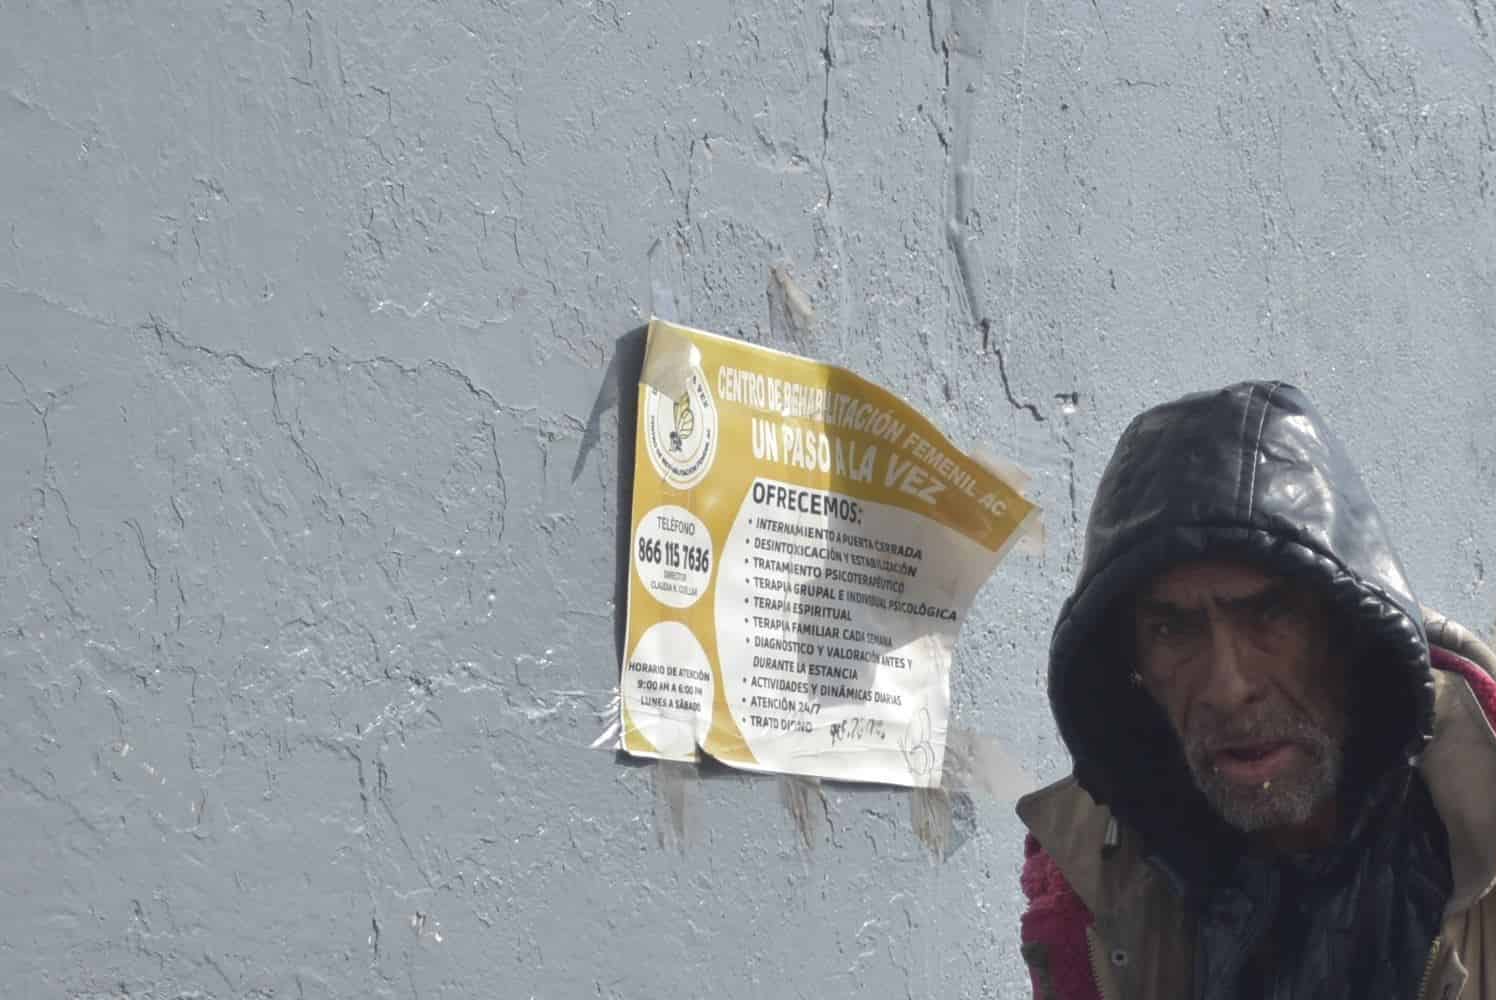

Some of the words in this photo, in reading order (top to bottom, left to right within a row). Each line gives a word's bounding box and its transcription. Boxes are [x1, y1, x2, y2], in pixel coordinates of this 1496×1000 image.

[718, 366, 765, 409] CENTRO
[767, 378, 783, 411] DE
[782, 382, 904, 442] REHABILITACIÓN
[903, 432, 976, 496] FEMENIL
[978, 493, 1007, 516] AC
[752, 417, 778, 462] UN
[782, 424, 831, 472] PASO
[835, 437, 847, 477] A
[851, 440, 877, 484] LA
[885, 453, 945, 504] VEZ
[752, 482, 864, 525] OFRECEMOS:
[657, 515, 695, 536] TELÉFONO
[754, 537, 842, 562] DESINTOXICACIÓN
[756, 517, 835, 541] INTERNAMIENTO
[842, 533, 873, 550] PUERTA
[875, 540, 923, 560] CERRADA
[639, 536, 661, 564] 866
[665, 541, 680, 568] 115
[682, 545, 709, 573] 7636
[753, 556, 821, 578] TRATAMIENTO
[753, 576, 792, 593] TERAPIA
[794, 583, 836, 600] GRUPAL
[889, 599, 957, 621] PSICOLÓGICA
[753, 596, 791, 613] TERAPIA
[792, 602, 852, 621] ESPIRITUAL
[753, 616, 790, 632] TERAPIA
[792, 622, 840, 639] FAMILIAR
[842, 629, 865, 642] CADA
[628, 662, 665, 675] HORARIO
[667, 666, 678, 677] DE
[753, 656, 794, 672] DURANTE
[797, 662, 806, 674] LA
[808, 663, 858, 681] ESTANCIA
[816, 646, 825, 656] Y
[907, 658, 913, 671] Y
[637, 679, 658, 690] 9:00
[751, 676, 808, 694] ACTIVIDADES
[811, 683, 818, 696] Y
[820, 684, 872, 703] DINÁMICAS
[874, 691, 902, 706] DIARIAS
[641, 695, 666, 708] LUNES
[751, 696, 796, 713] ATENCIÓN
[798, 701, 821, 715] 24/7
[750, 715, 779, 729] TRATO
